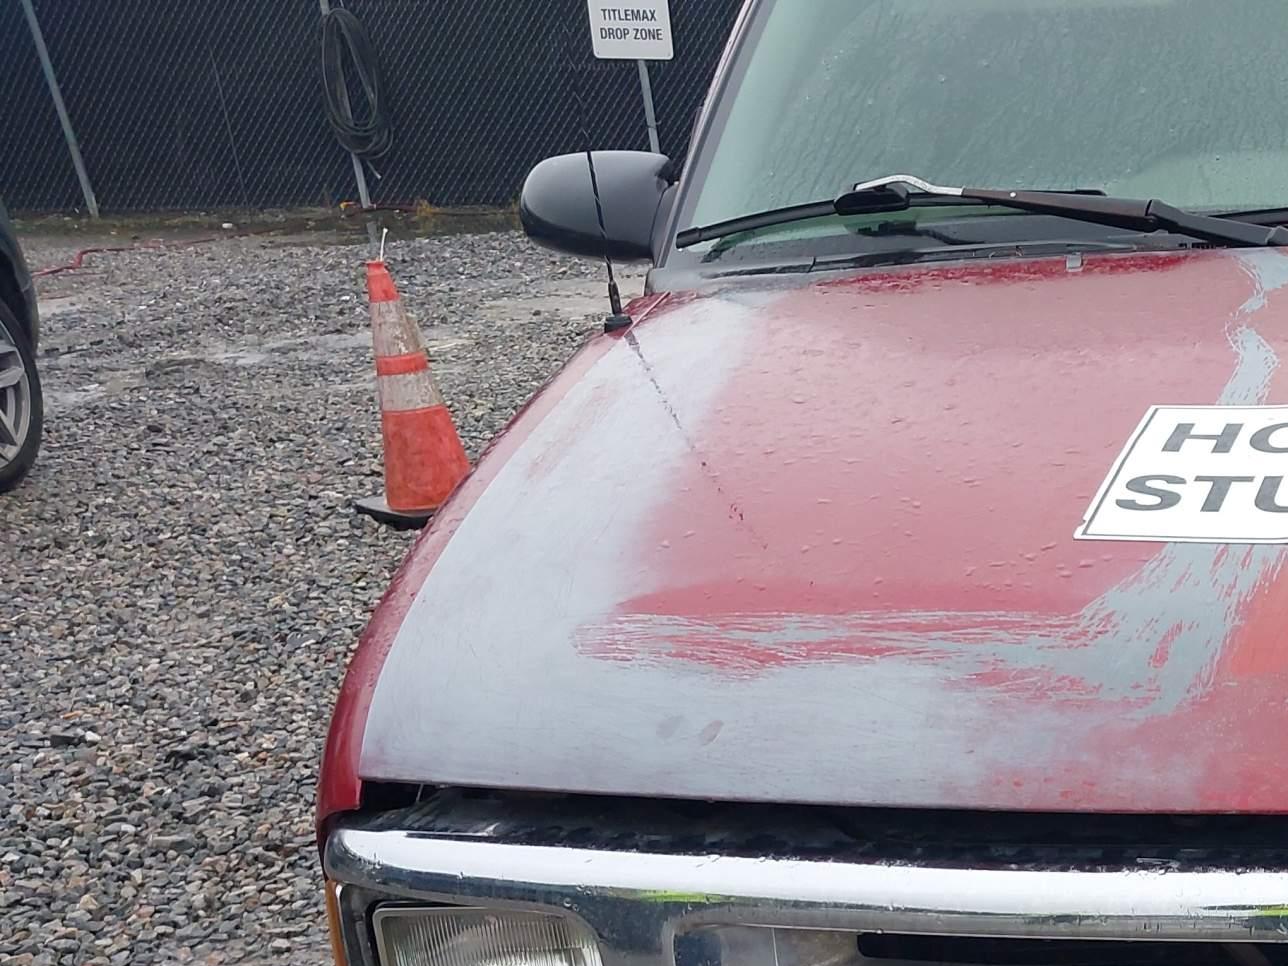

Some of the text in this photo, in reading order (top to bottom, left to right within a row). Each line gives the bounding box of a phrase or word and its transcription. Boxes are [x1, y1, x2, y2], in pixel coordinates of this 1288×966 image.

[600, 8, 657, 21] TITLEMAX
[600, 27, 663, 40] DROP ZONE
